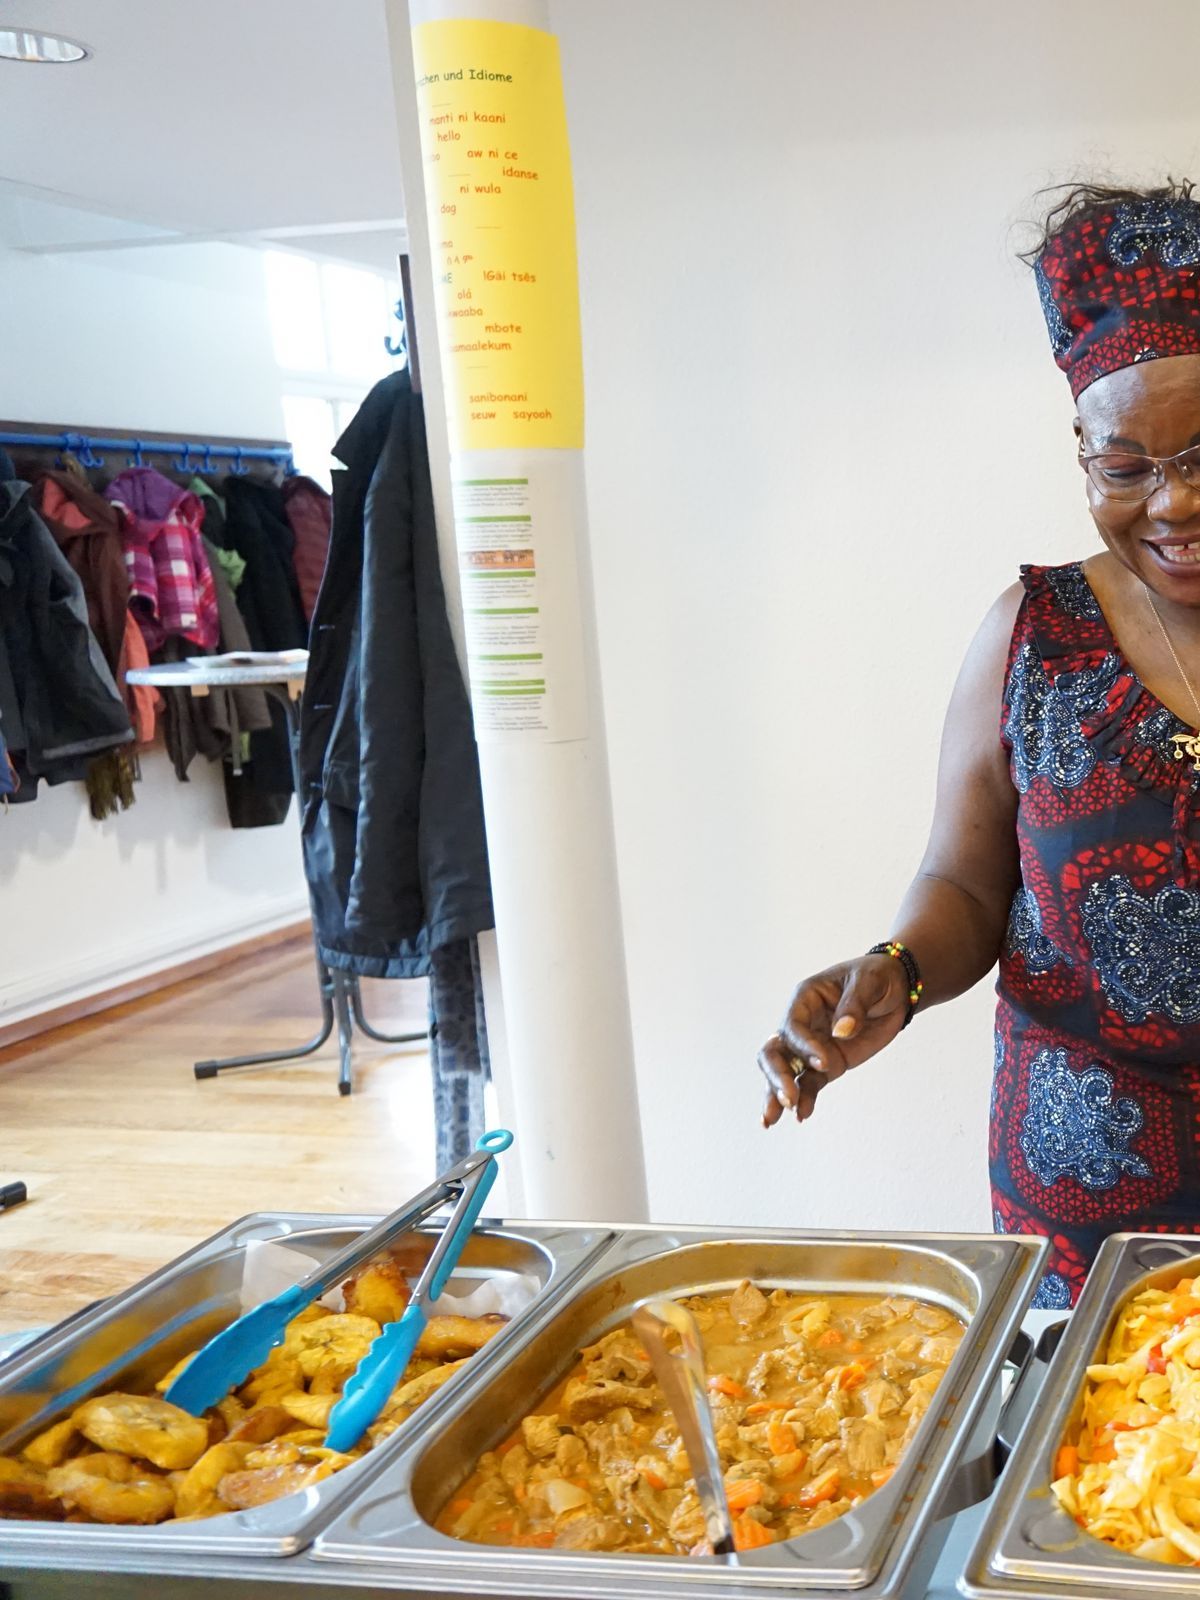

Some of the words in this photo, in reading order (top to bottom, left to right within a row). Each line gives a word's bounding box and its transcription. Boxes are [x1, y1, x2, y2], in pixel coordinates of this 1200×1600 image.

[443, 69, 463, 81] und
[468, 69, 513, 83] Idiome
[458, 112, 468, 122] ni
[473, 112, 506, 123] kaani
[437, 131, 461, 142] hello
[467, 150, 483, 159] aw
[488, 148, 499, 158] ni
[504, 151, 519, 160] ce
[502, 166, 539, 180] idanse
[459, 183, 470, 193] ni
[474, 182, 502, 194] wula
[484, 322, 523, 334] mbote
[469, 391, 529, 403] sanibonani
